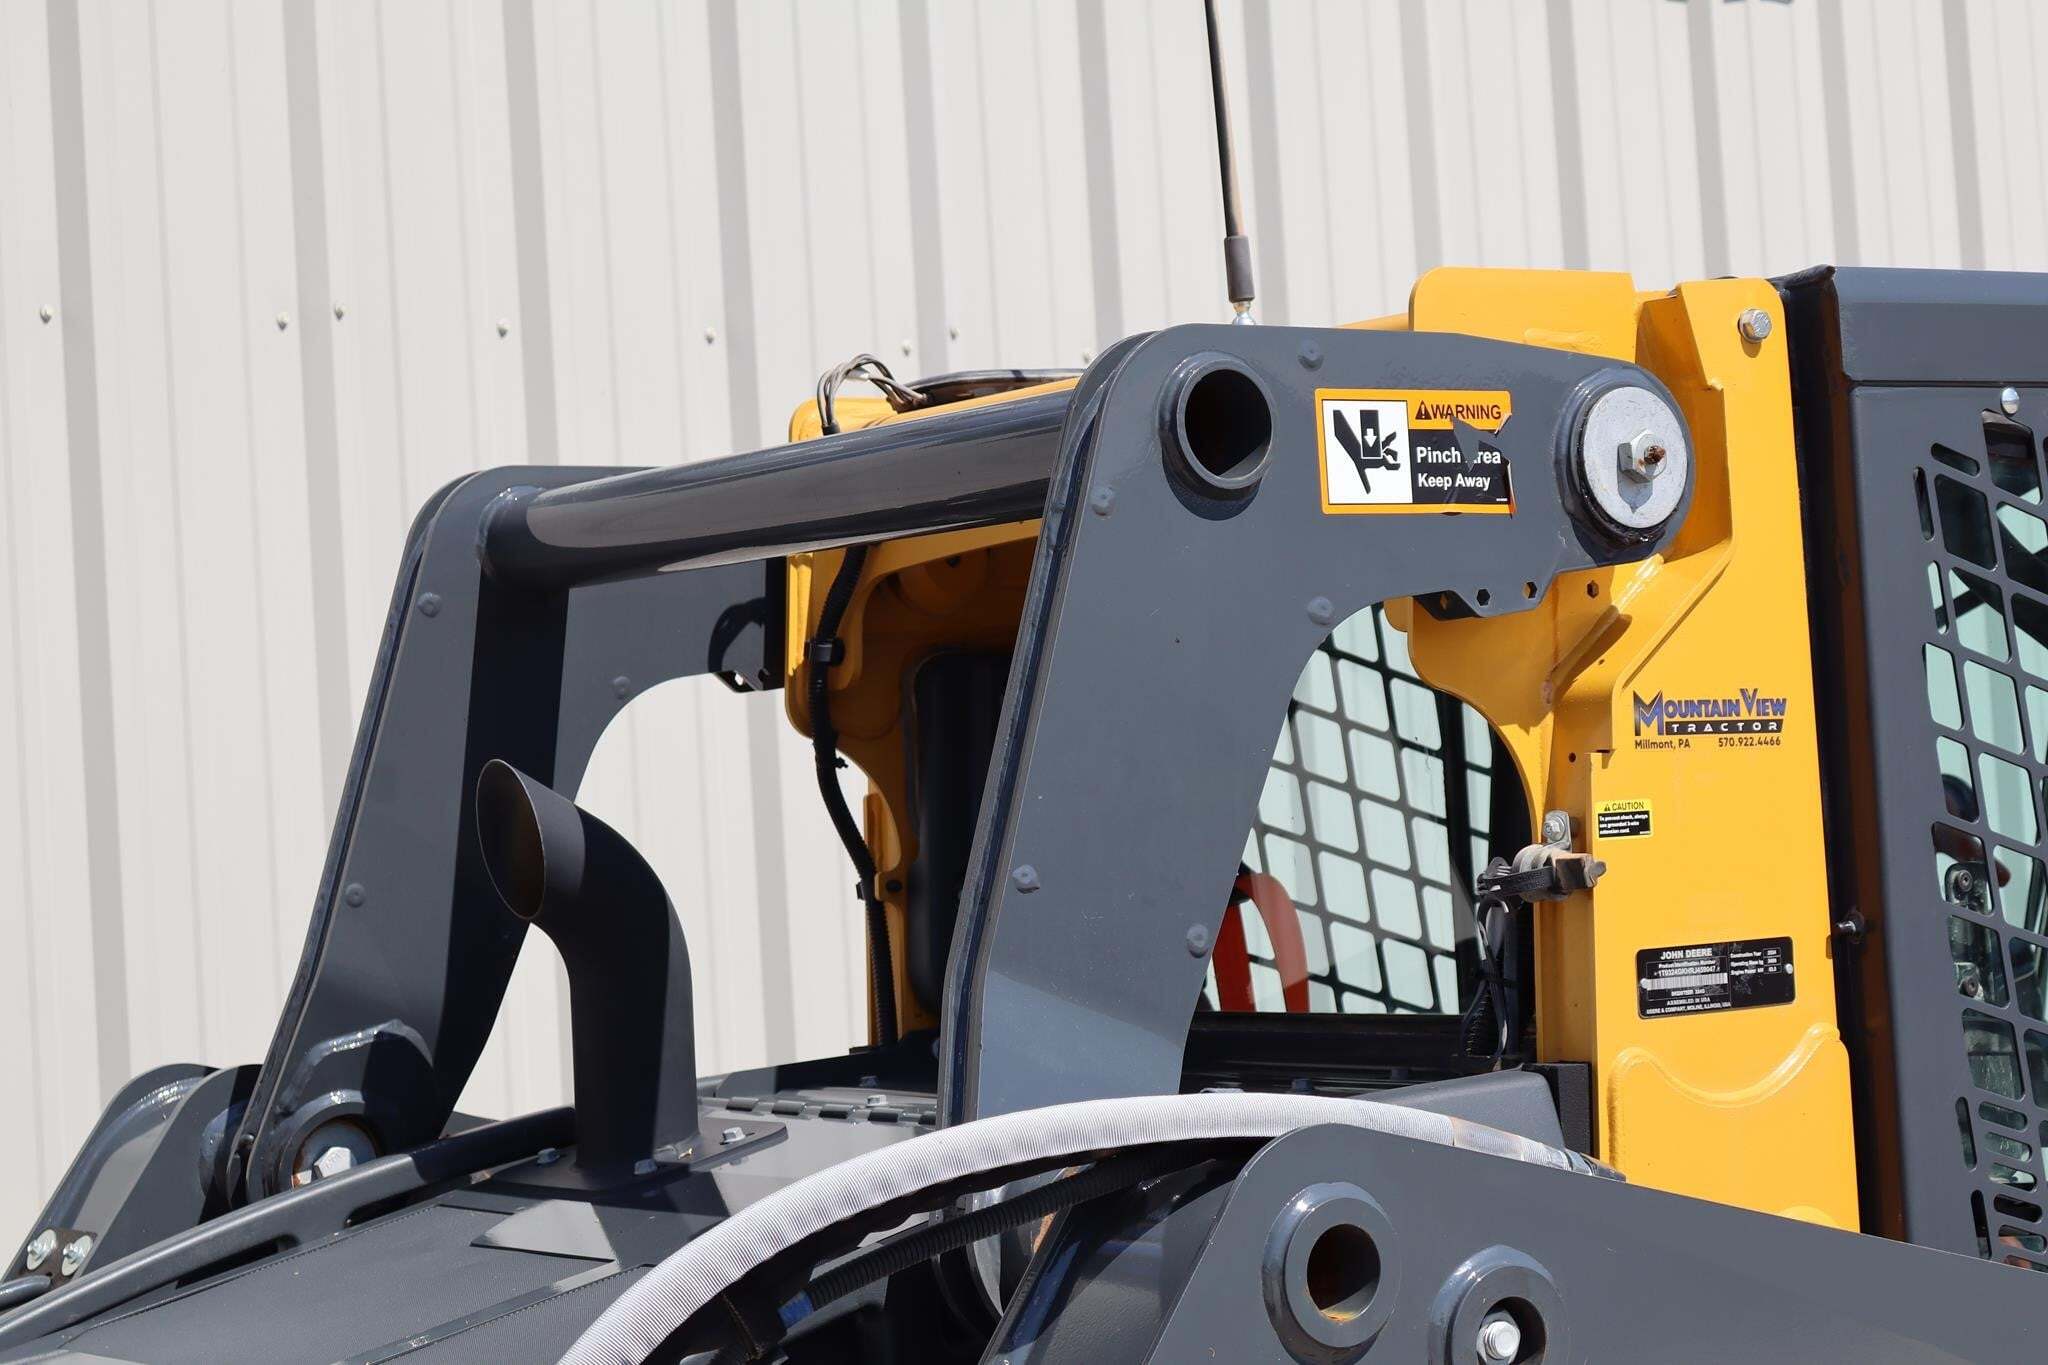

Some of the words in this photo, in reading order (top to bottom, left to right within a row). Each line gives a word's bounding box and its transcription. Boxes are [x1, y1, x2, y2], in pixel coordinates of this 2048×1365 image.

[1431, 404, 1501, 420] WARNING
[1416, 446, 1461, 464] Pinch
[1465, 450, 1501, 464] rea
[1418, 473, 1452, 490] Keep
[1455, 474, 1491, 491] Away
[1633, 689, 1741, 736] MOUNTAIN
[1739, 688, 1787, 717] VIEW
[1671, 722, 1778, 733] TRACTOR
[1634, 738, 1676, 750] Millmont,
[1678, 738, 1691, 748] PA
[1718, 736, 1781, 747] 570.922.4466
[1612, 802, 1644, 811] CAUTION
[1660, 950, 1684, 960] JOHN
[1685, 948, 1713, 958] DEERE
